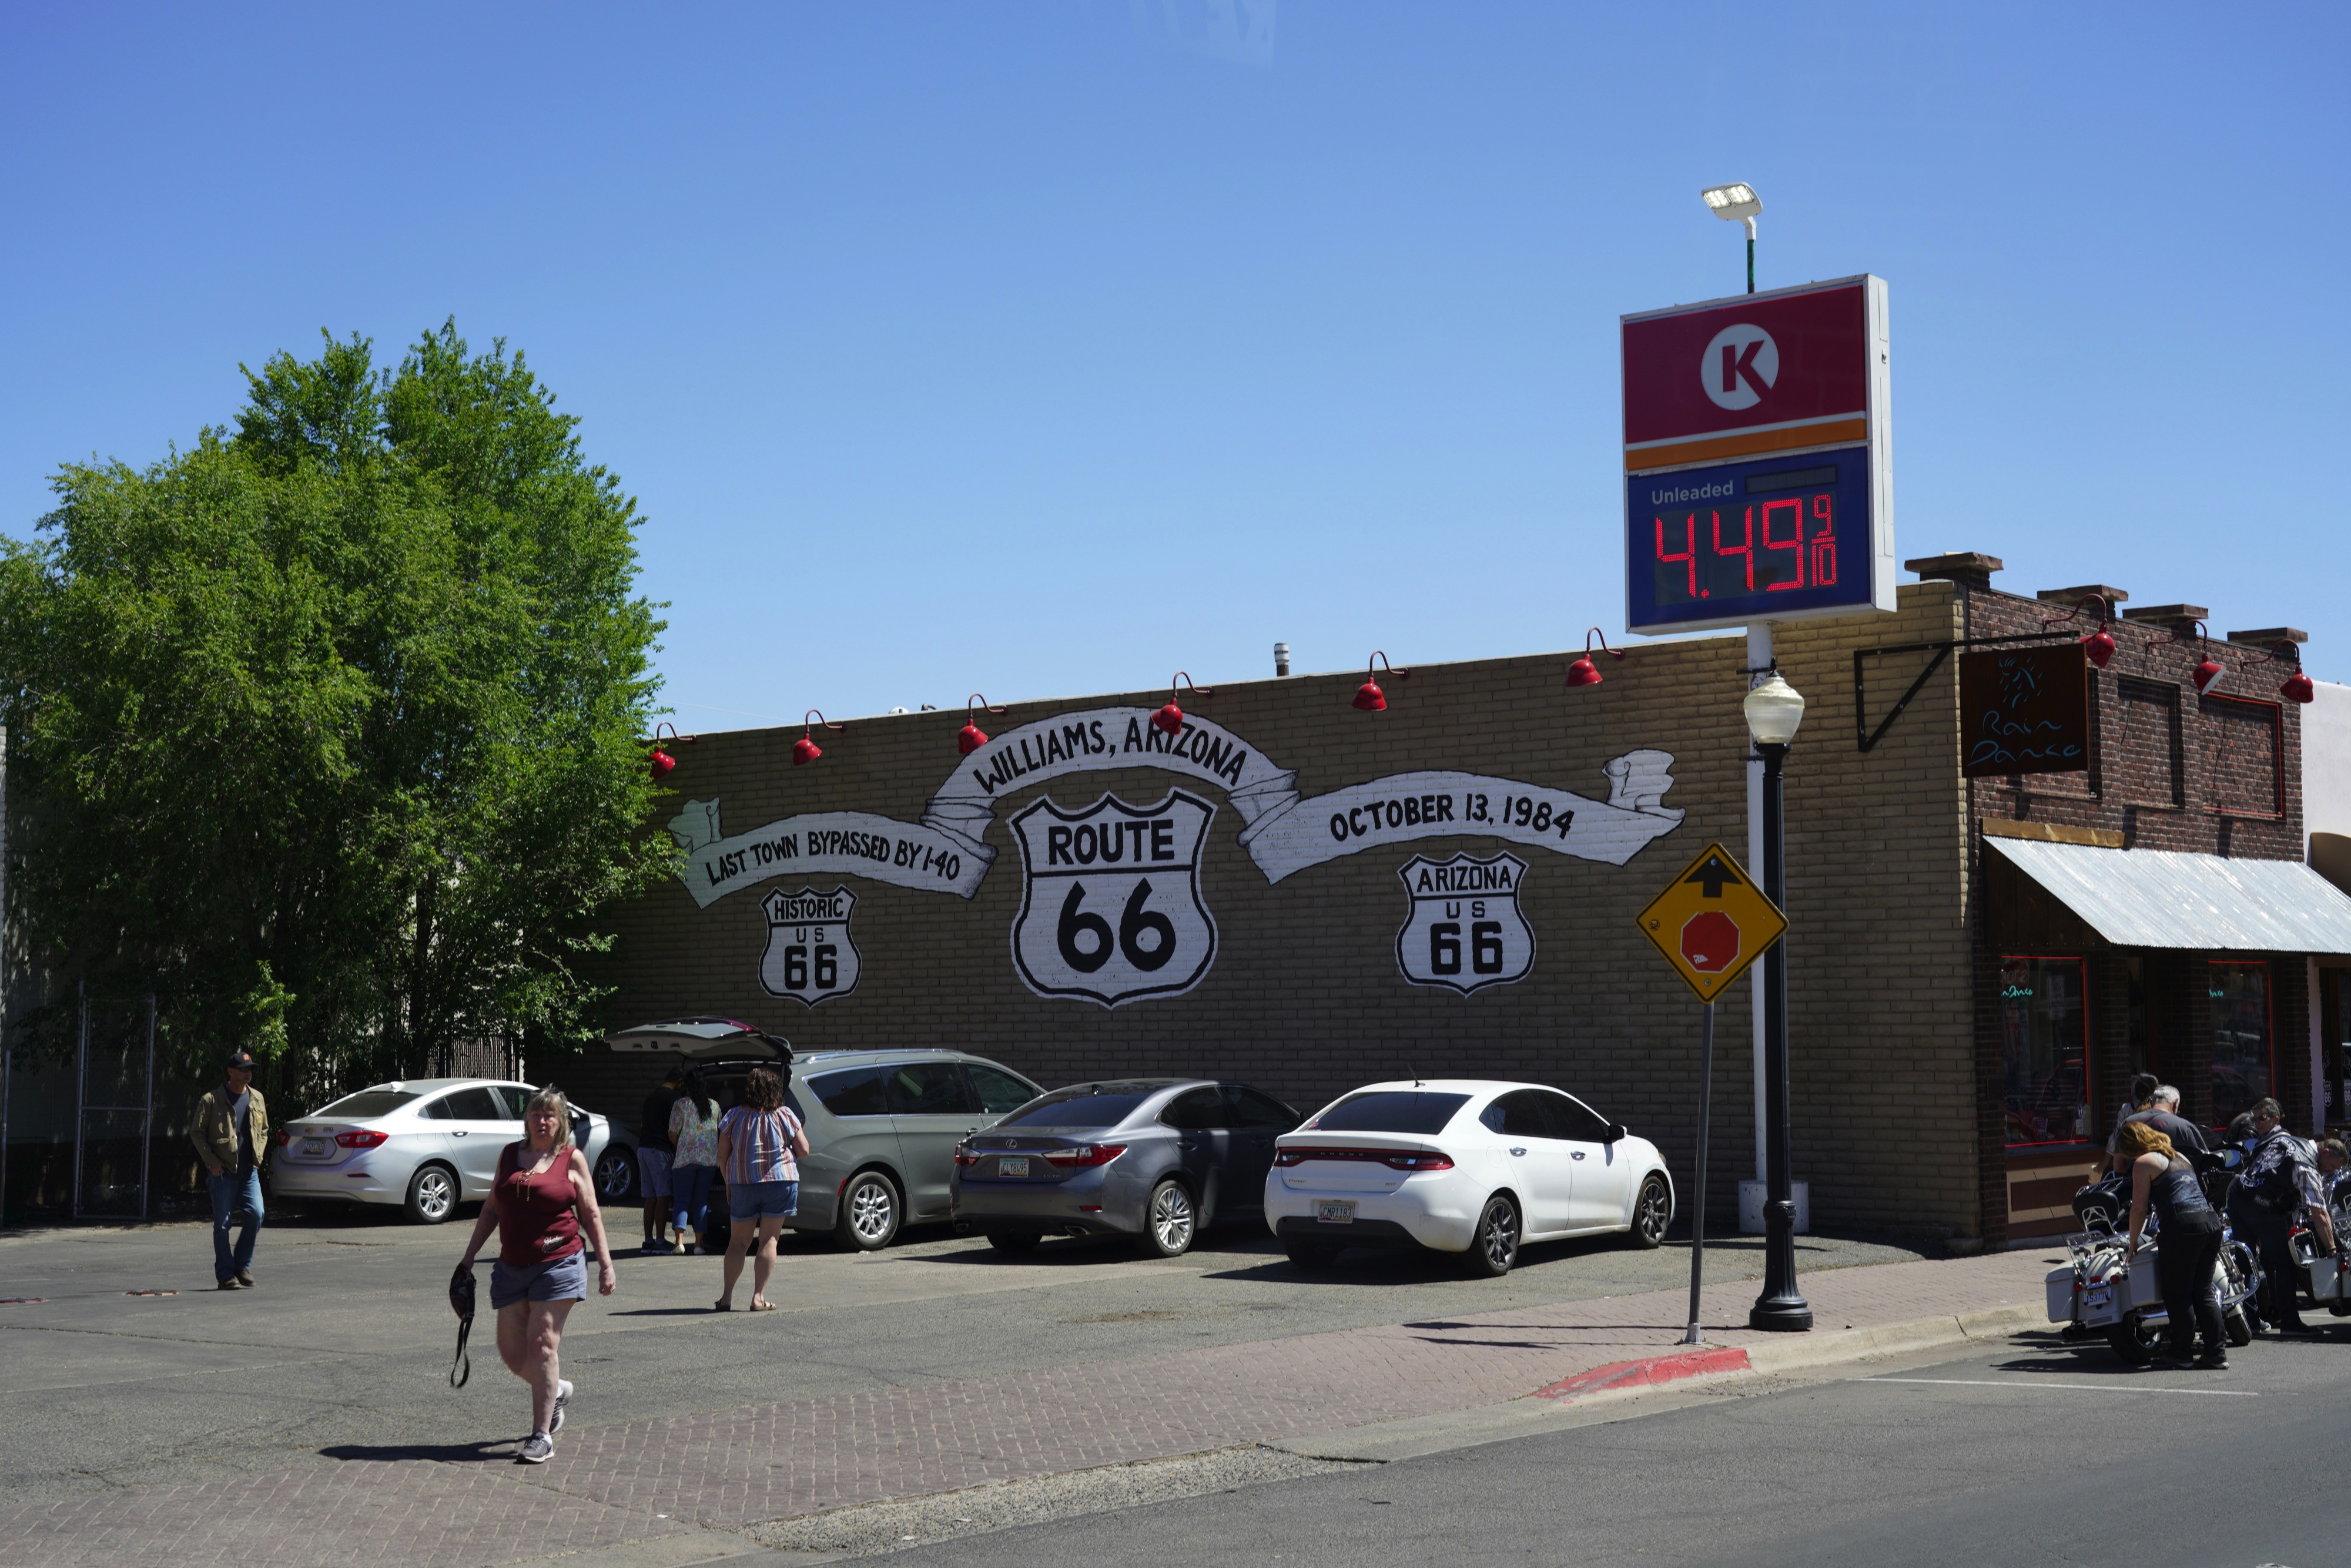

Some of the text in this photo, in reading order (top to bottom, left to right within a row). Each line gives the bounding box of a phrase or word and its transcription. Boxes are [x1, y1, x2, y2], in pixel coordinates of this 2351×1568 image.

[1722, 339, 1772, 403] K
[1652, 480, 1734, 505] Unleaded
[1656, 498, 1804, 599] 4.49
[1982, 710, 2062, 736] Rain
[973, 716, 1247, 795] WILLIAMS, ARIZONA
[1967, 740, 2081, 766] Dance
[1330, 793, 1575, 842] OCTOBER 13, 1984
[705, 830, 960, 887] LAST TOWN BYPASSED BY I-40
[1048, 819, 1174, 866] ROUTE
[1416, 865, 1513, 893] ARIZONA
[774, 897, 845, 920] HISTORIC
[1057, 877, 1177, 973] 66
[784, 945, 838, 990] 66
[1430, 921, 1503, 976] 66
[2324, 1091, 2332, 1104] 66
[1003, 1162, 1027, 1173] CLY8495
[1323, 1207, 1352, 1218] CMR1183
